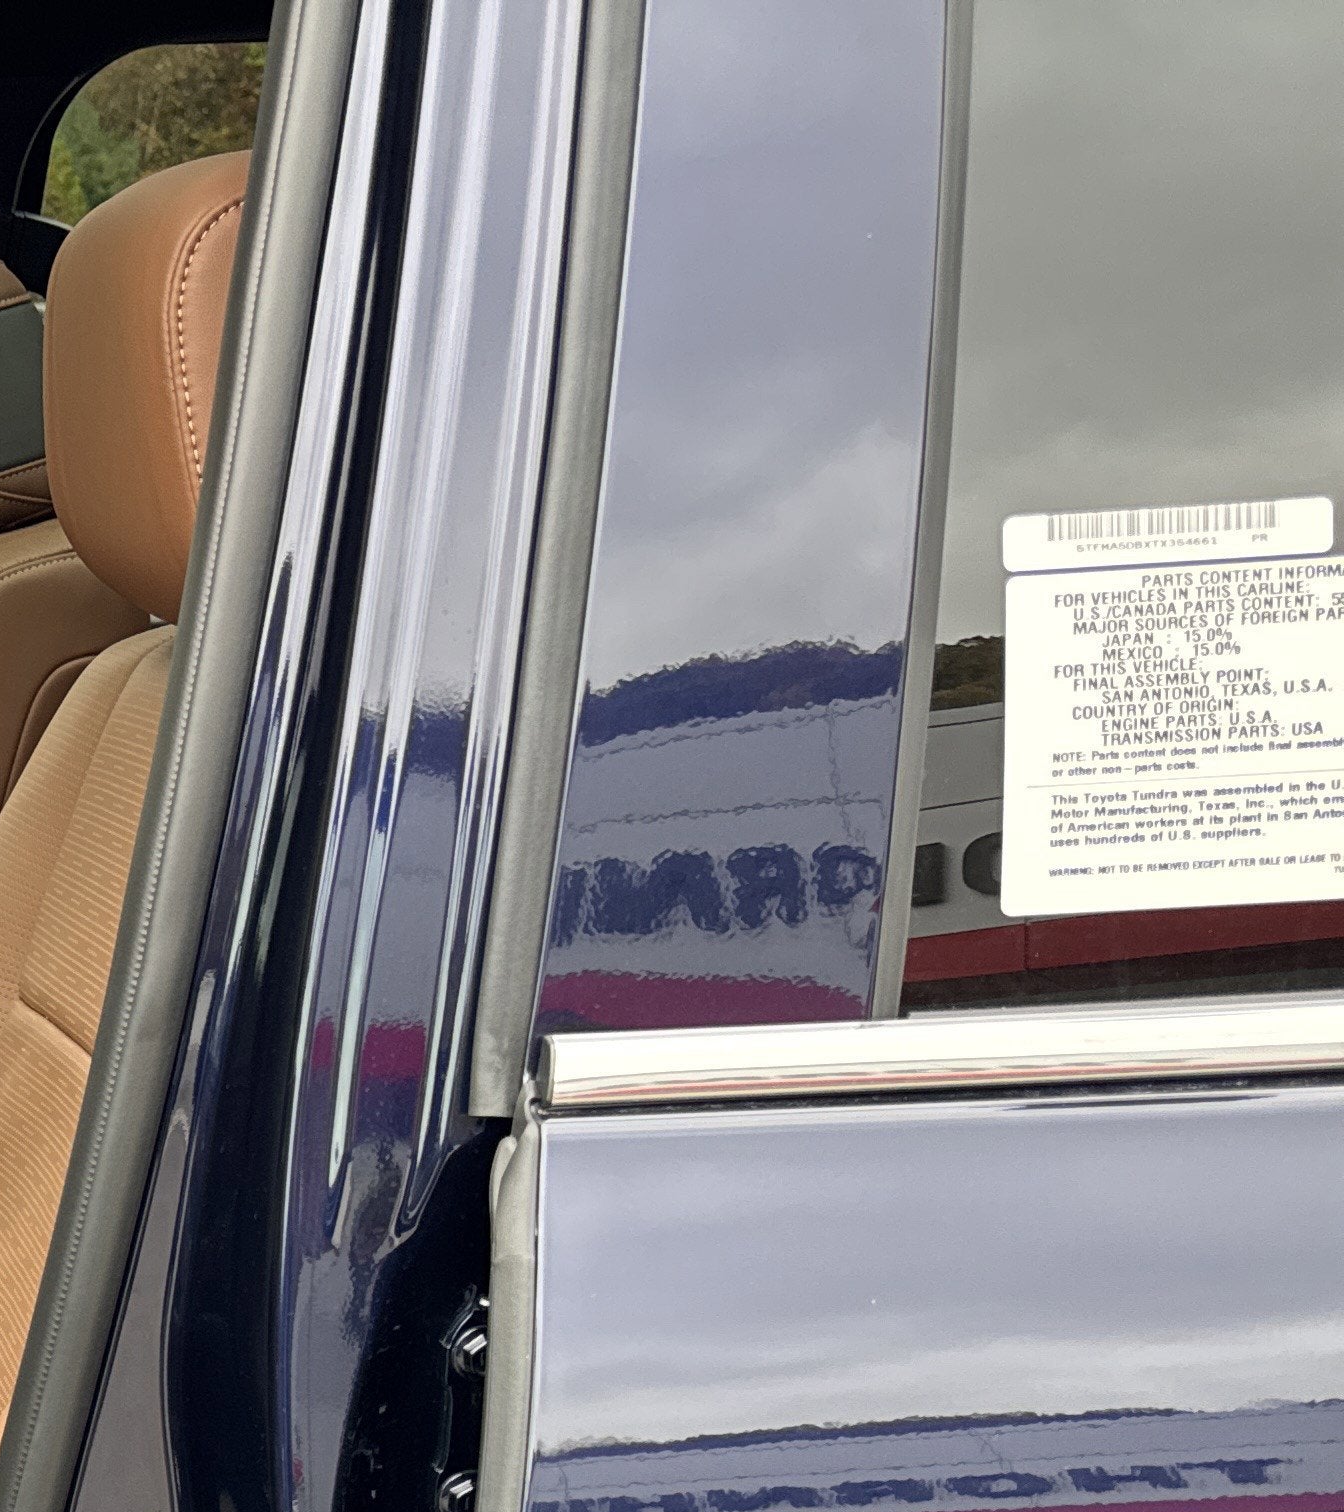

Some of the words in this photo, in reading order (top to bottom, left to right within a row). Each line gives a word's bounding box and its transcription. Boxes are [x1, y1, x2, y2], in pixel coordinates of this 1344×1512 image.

[1141, 572, 1194, 588] PARTS
[1199, 568, 1272, 585] CONTENT
[1278, 564, 1344, 580] INFORM
[1054, 593, 1085, 608] FOR
[1091, 588, 1166, 605] VEHICLES
[1173, 587, 1188, 600] IN
[1195, 585, 1231, 599] THIS
[1237, 580, 1310, 597] CARLINE:
[1183, 599, 1235, 615] PARTS
[1241, 594, 1320, 611] CONTENT:
[1073, 619, 1128, 635] MAJOR
[1135, 614, 1208, 631] SOURCES
[1214, 613, 1234, 627] OF
[1241, 608, 1309, 625] FOREIGN
[1102, 633, 1153, 647] JAPAN
[1102, 646, 1163, 661] MEXICO
[1054, 664, 1085, 679] FOR
[1090, 661, 1127, 676] THIS
[1133, 657, 1203, 674] VEHICLE:
[1073, 677, 1118, 692] FINAL
[1124, 671, 1210, 688] ASSEMBLY
[1216, 668, 1269, 683] POINT:
[1102, 690, 1134, 704] SAN
[1222, 681, 1277, 697] TEXAS,
[1283, 678, 1332, 694] U.S.A.
[1072, 703, 1148, 720] COUNTRY
[1153, 702, 1173, 715] OF
[1179, 698, 1239, 714] ORIGIN:
[1101, 717, 1159, 732] ENGINE
[1165, 713, 1223, 729] PARTS:
[1101, 727, 1221, 746] TRANSMISSION
[1228, 723, 1285, 739] PARTS:
[1291, 721, 1324, 736] USA
[1091, 750, 1119, 761] Parts
[1123, 747, 1166, 759] content
[1170, 746, 1196, 756] does
[1052, 769, 1064, 777] or
[1068, 766, 1097, 777] other
[1051, 794, 1078, 805] This
[1084, 792, 1127, 804] Toyota
[1132, 789, 1178, 801] Tundra
[1182, 789, 1207, 799] was
[1213, 782, 1283, 796] assembled
[1288, 782, 1301, 792] in
[1305, 780, 1325, 791] the
[1051, 808, 1089, 819] Motor
[1279, 795, 1318, 807] which
[1050, 822, 1063, 833] of
[1067, 821, 1129, 833] American
[1135, 817, 1187, 829] workers
[1192, 816, 1204, 826] at
[1209, 815, 1224, 825] its
[1229, 812, 1262, 826] plant
[1267, 812, 1279, 822] in
[1283, 810, 1308, 821] San
[1313, 808, 1344, 819] Anto
[1049, 838, 1080, 847] uses
[1084, 833, 1146, 845] hundreds
[1151, 831, 1163, 842] of
[1200, 827, 1266, 841] suppliers.
[1119, 864, 1130, 873] TO
[1132, 863, 1143, 872] BE
[1228, 857, 1256, 867] AFTER
